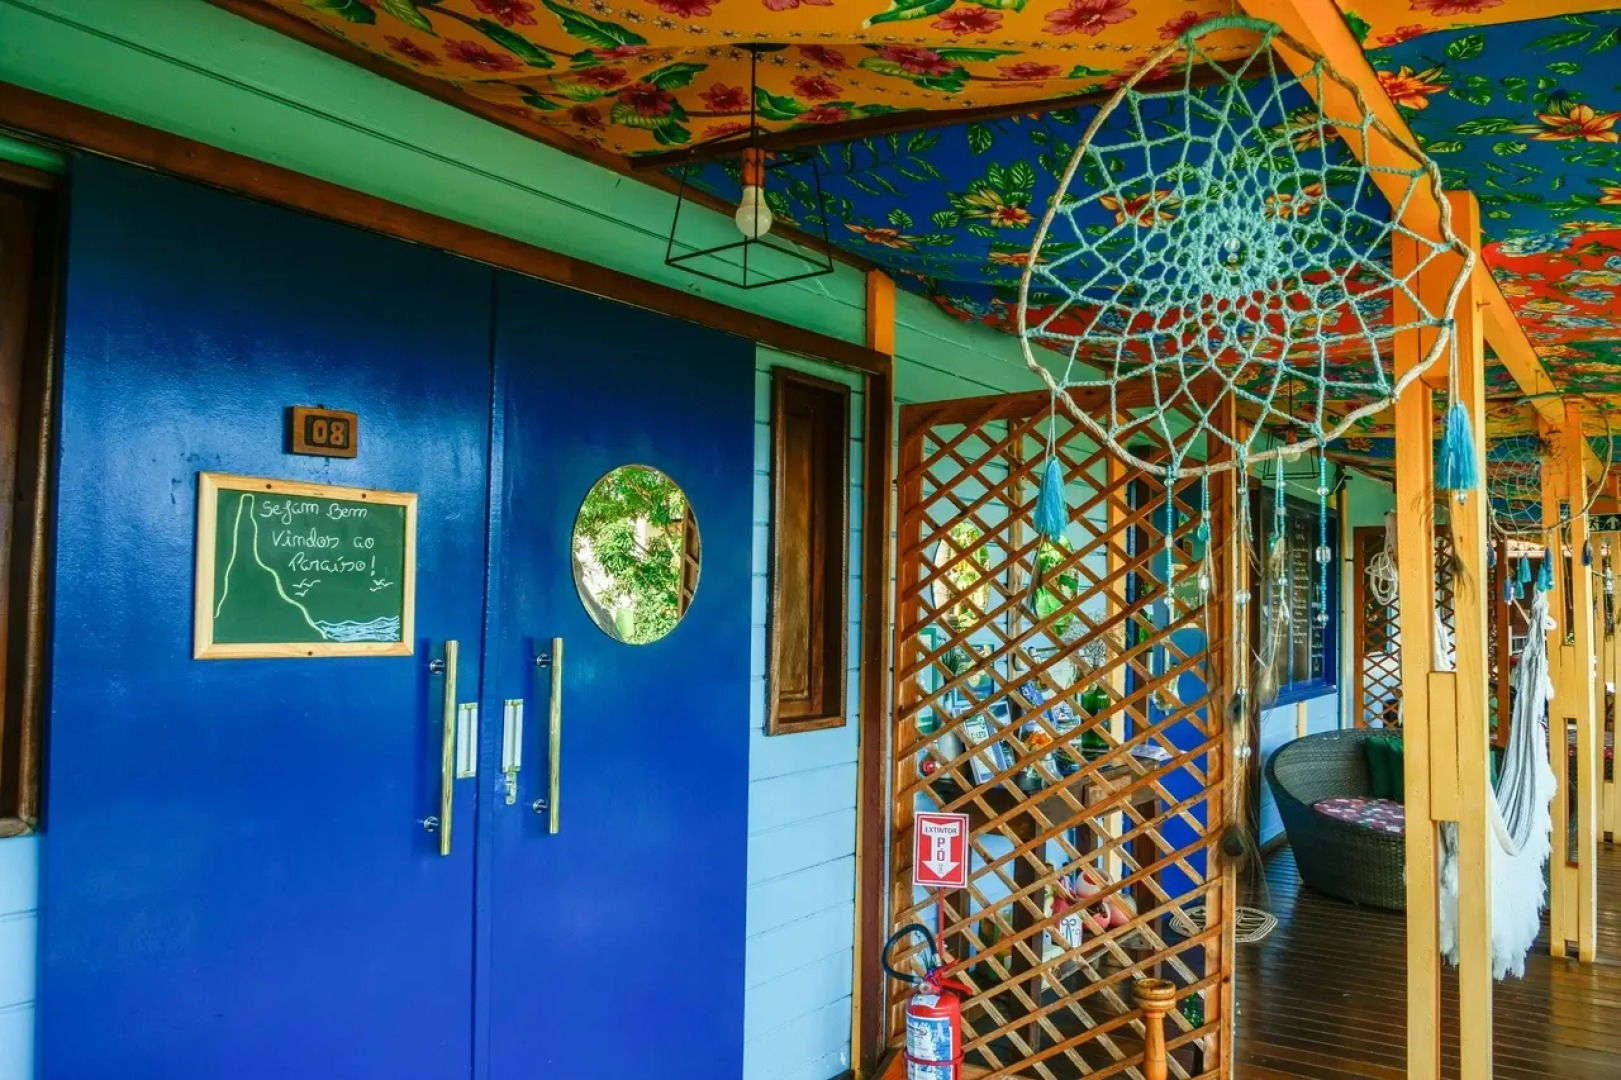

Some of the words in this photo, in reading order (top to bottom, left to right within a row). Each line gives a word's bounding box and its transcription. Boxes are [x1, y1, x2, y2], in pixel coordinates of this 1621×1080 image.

[313, 419, 344, 446] 08
[326, 503, 368, 520] Bem
[272, 527, 340, 549] Vindos
[925, 826, 957, 834] EXTINTOR
